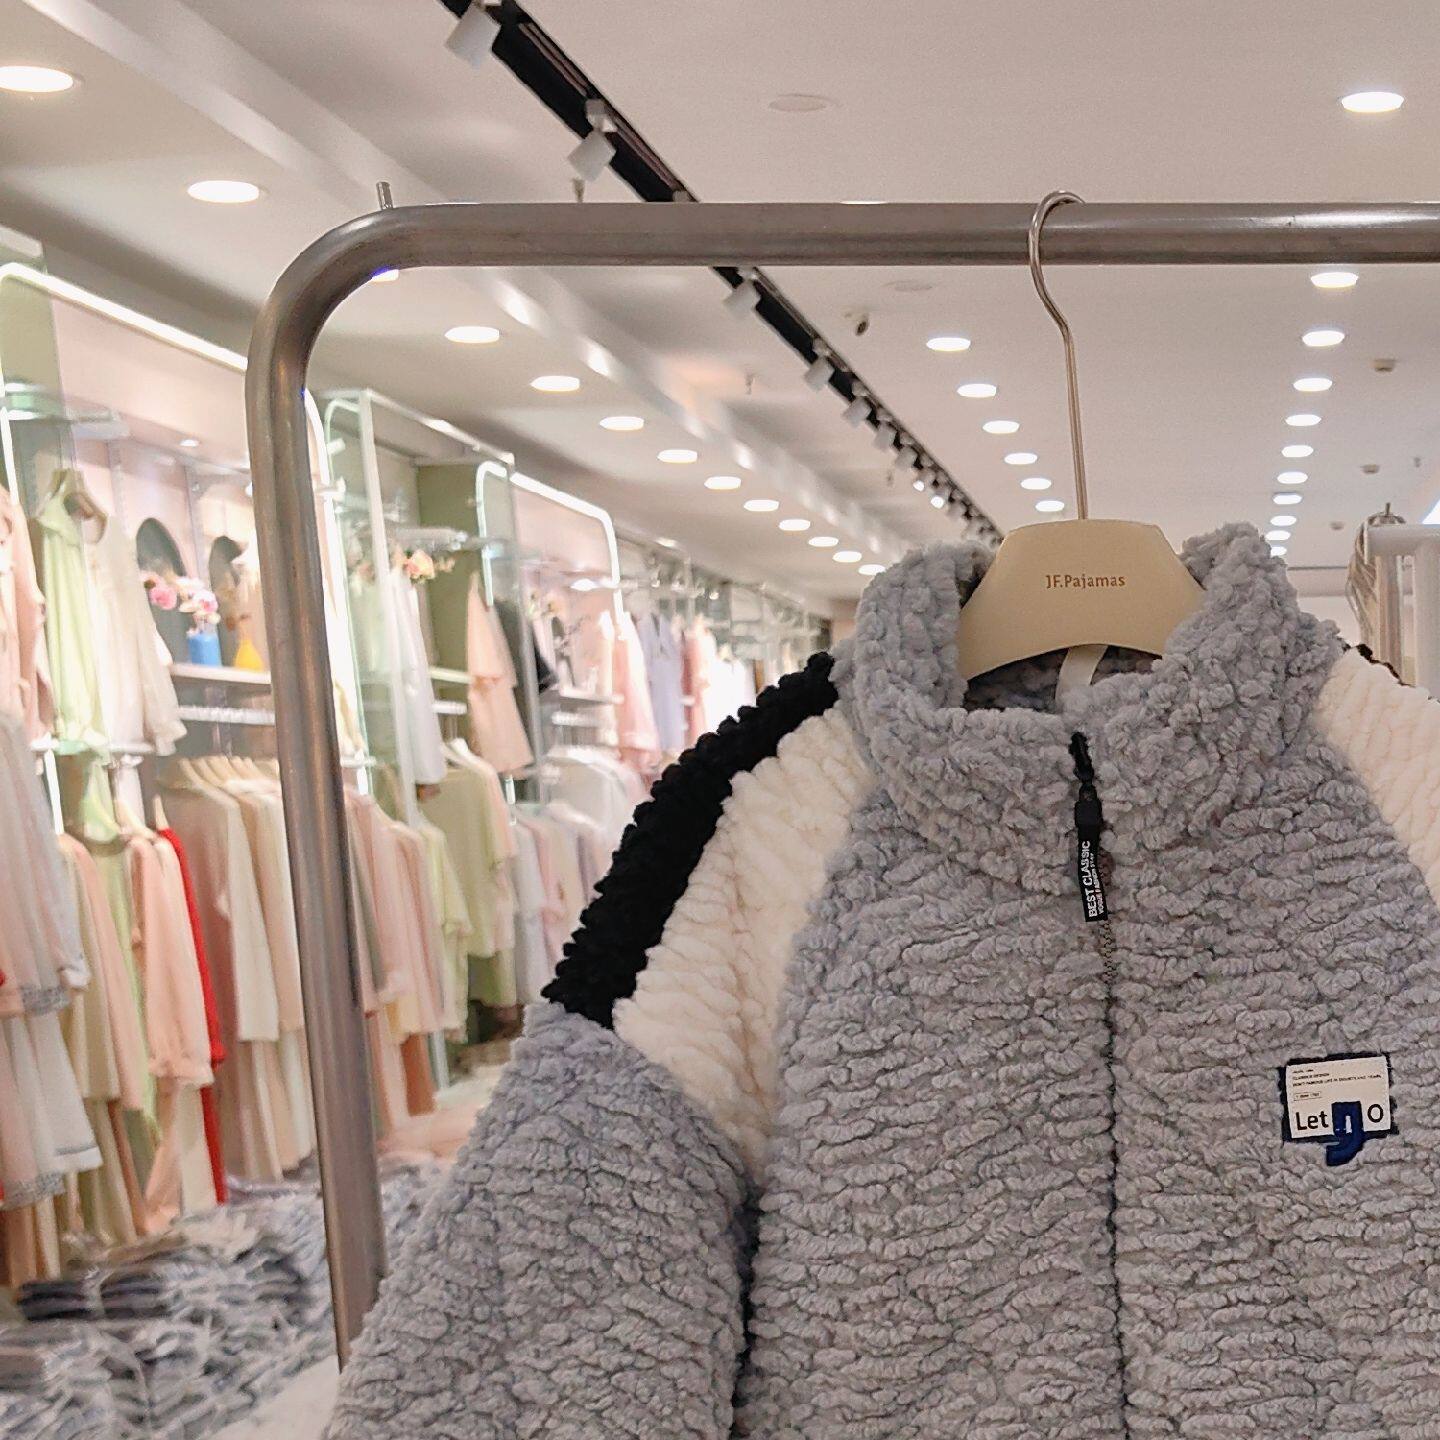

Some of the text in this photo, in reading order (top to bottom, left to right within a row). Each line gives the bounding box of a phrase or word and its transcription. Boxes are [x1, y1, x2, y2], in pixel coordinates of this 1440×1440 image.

[1045, 573, 1126, 589] JF.Pajamas
[1080, 840, 1098, 918] BEST CLASSIC
[1295, 1110, 1330, 1131] Let
